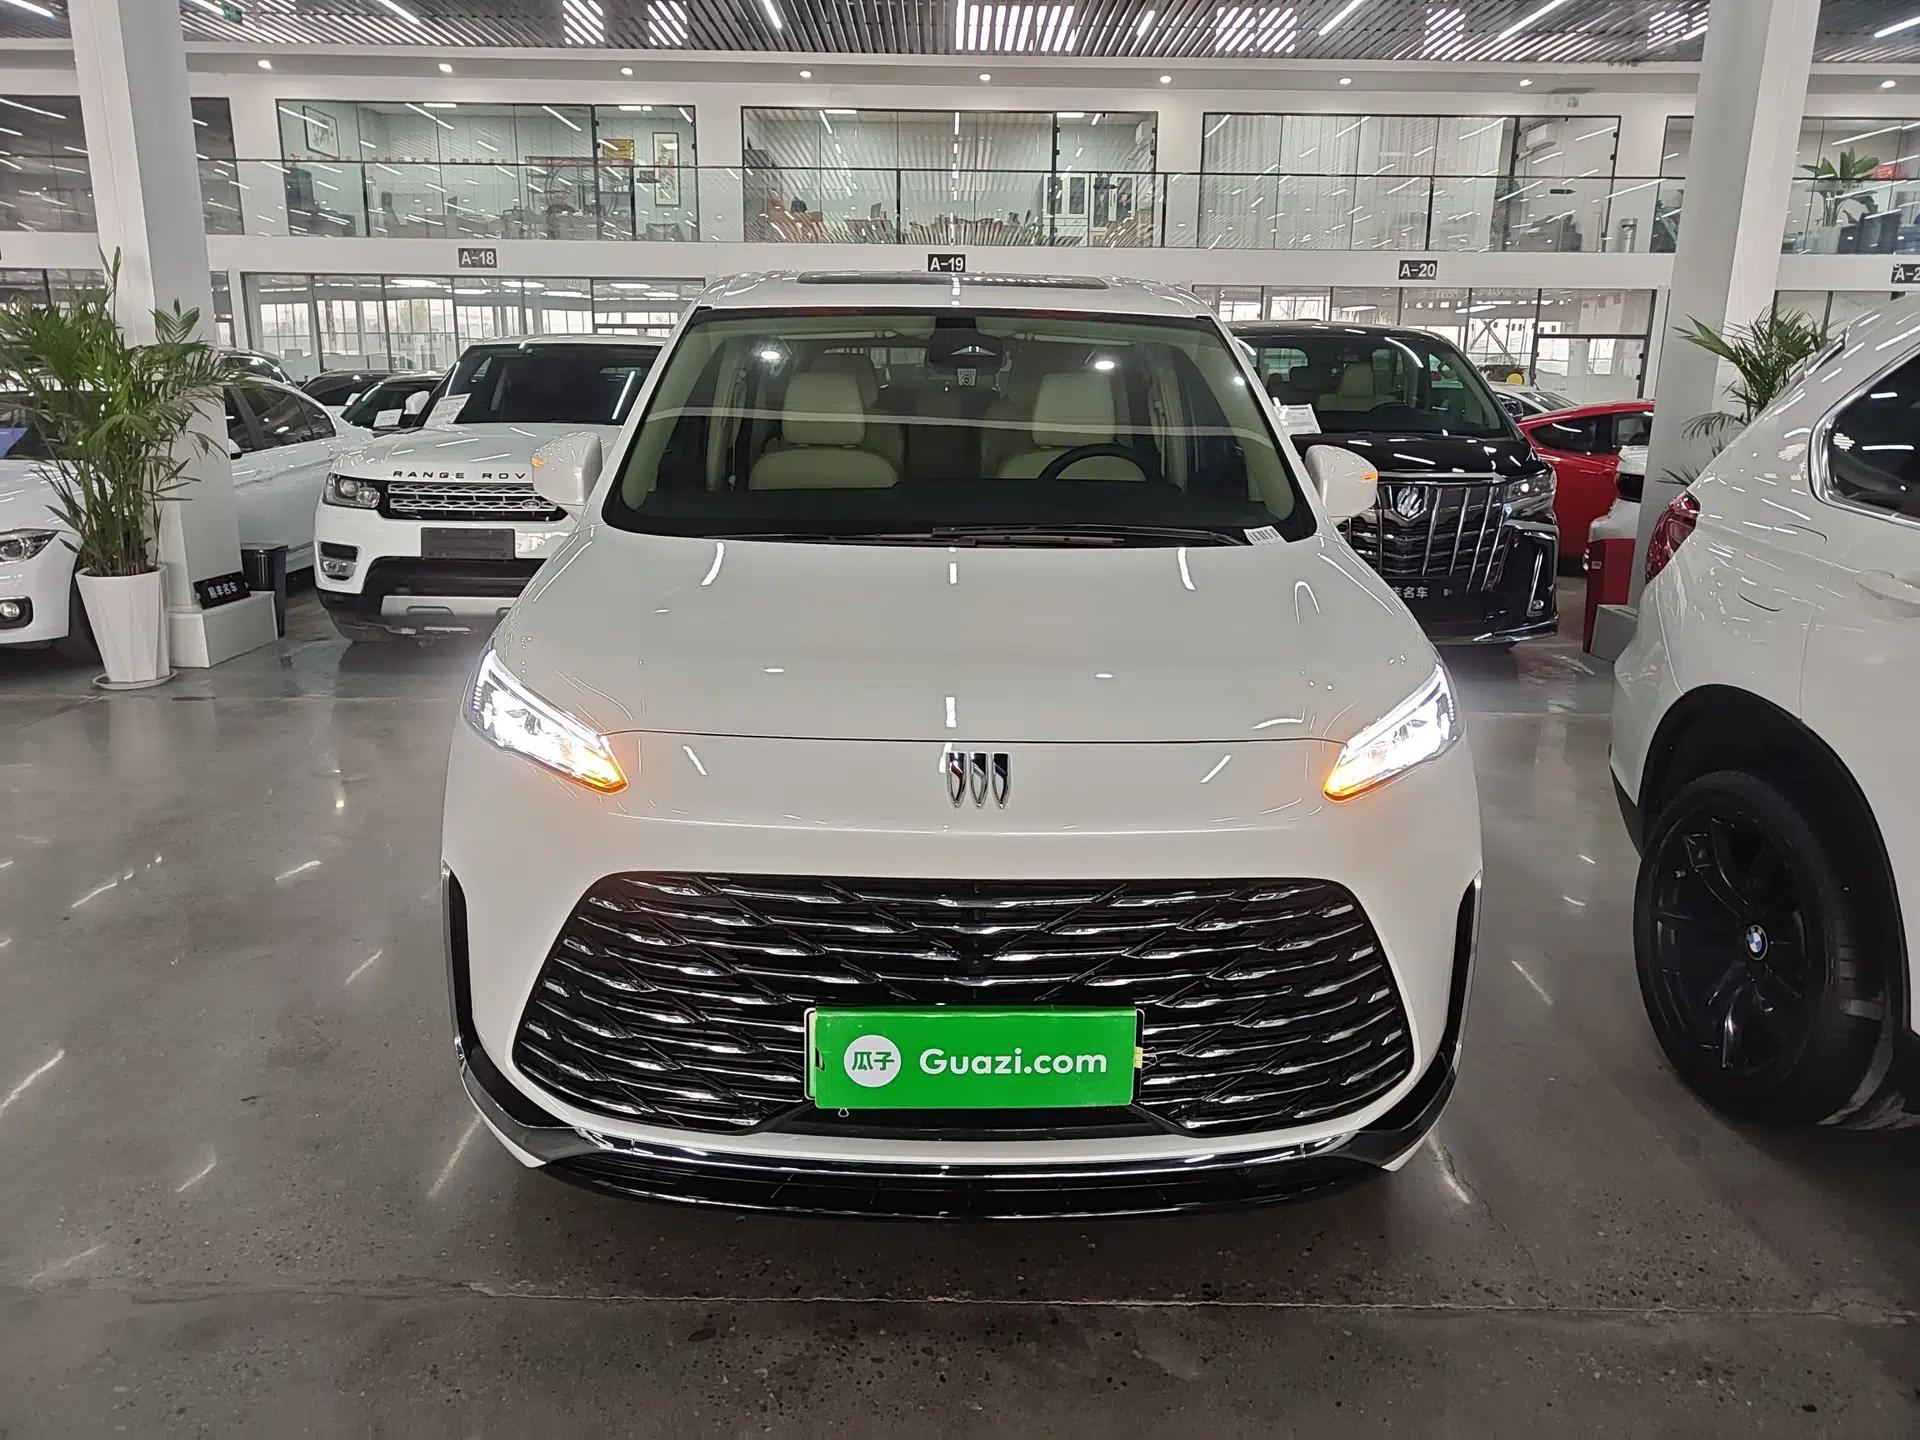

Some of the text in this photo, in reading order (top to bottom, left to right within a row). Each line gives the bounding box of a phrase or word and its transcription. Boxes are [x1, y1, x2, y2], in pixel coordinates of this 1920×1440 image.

[461, 251, 495, 265] A-18
[930, 257, 964, 271] A-19
[1400, 263, 1436, 277] A-20
[1894, 267, 1920, 281] A-2
[393, 470, 526, 480] RANGE ROV
[851, 1047, 1107, 1075] 瓜子 Guazi.com
